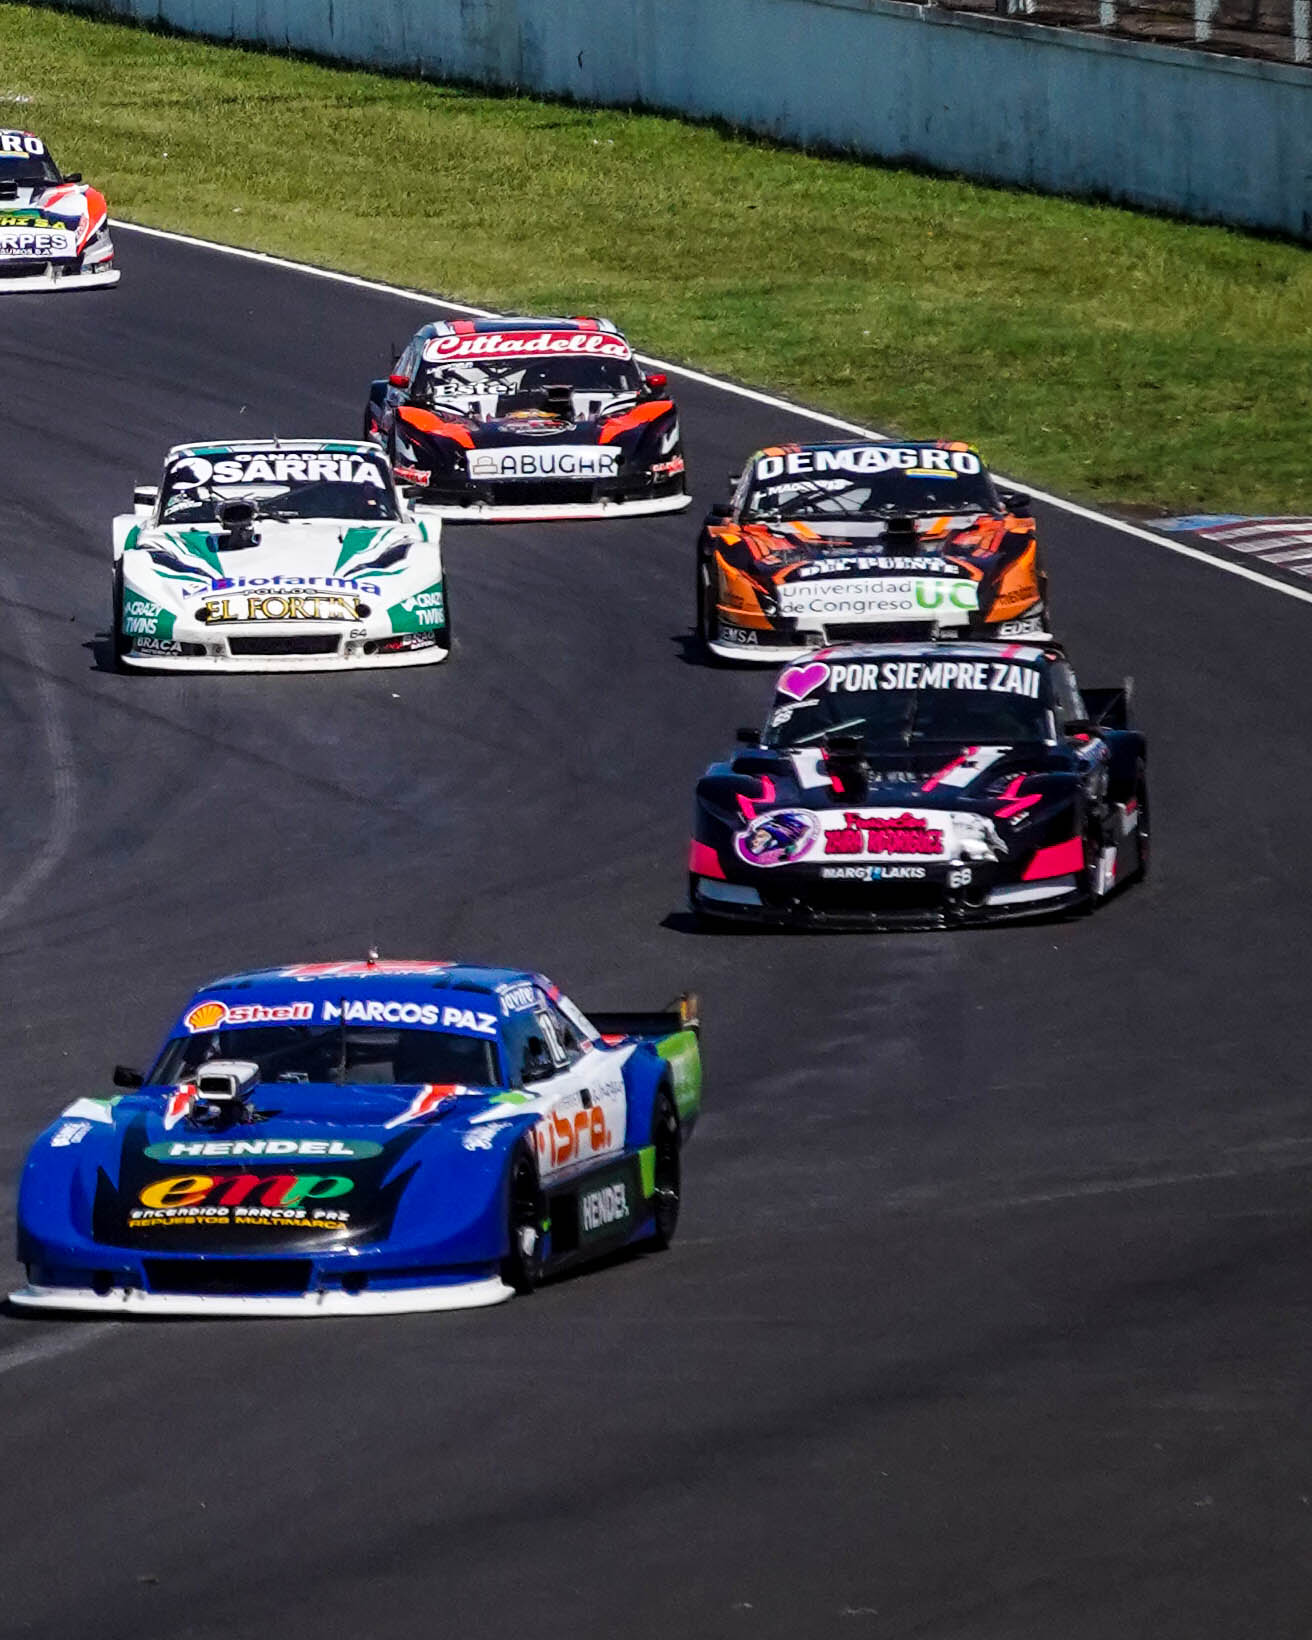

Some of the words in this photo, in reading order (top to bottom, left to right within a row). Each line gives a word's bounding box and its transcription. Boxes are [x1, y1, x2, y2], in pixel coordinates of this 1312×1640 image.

[427, 334, 627, 359] Cittadella
[212, 460, 386, 489] SARRIA
[757, 449, 980, 480] DEMAGRO
[211, 575, 382, 597] Biofarma
[783, 580, 912, 598] Universidad
[915, 581, 979, 609] UC
[809, 598, 913, 615] Congreso
[827, 665, 878, 693] POR
[881, 663, 988, 690] SIEMPRE
[228, 1004, 313, 1022] Shell
[322, 1001, 440, 1024] MARCOS
[443, 1008, 497, 1034] PAZ
[169, 1141, 355, 1155] HENDEL
[139, 1173, 355, 1208] emp
[129, 1217, 230, 1228] REPUESTOS
